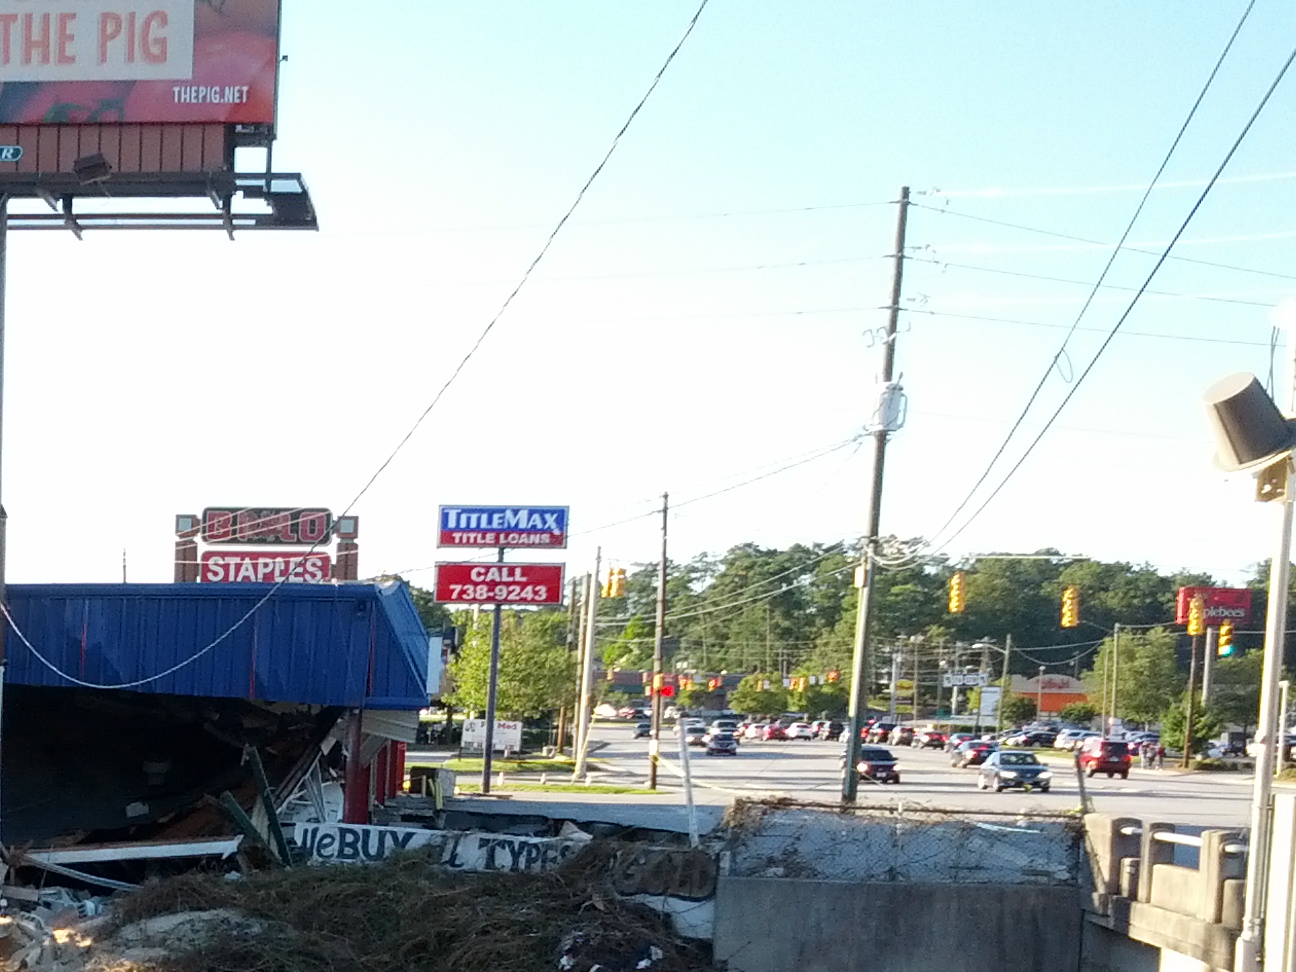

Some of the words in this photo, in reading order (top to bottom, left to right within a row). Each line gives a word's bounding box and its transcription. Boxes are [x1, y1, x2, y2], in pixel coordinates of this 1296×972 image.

[97, 10, 169, 65] PIG
[172, 86, 249, 104] THEPIG.NET
[452, 532, 495, 544] TITLE
[499, 533, 550, 545] LOANS
[206, 556, 324, 583] STAPLES
[470, 567, 528, 582] CALL
[449, 585, 548, 601] 738-9243
